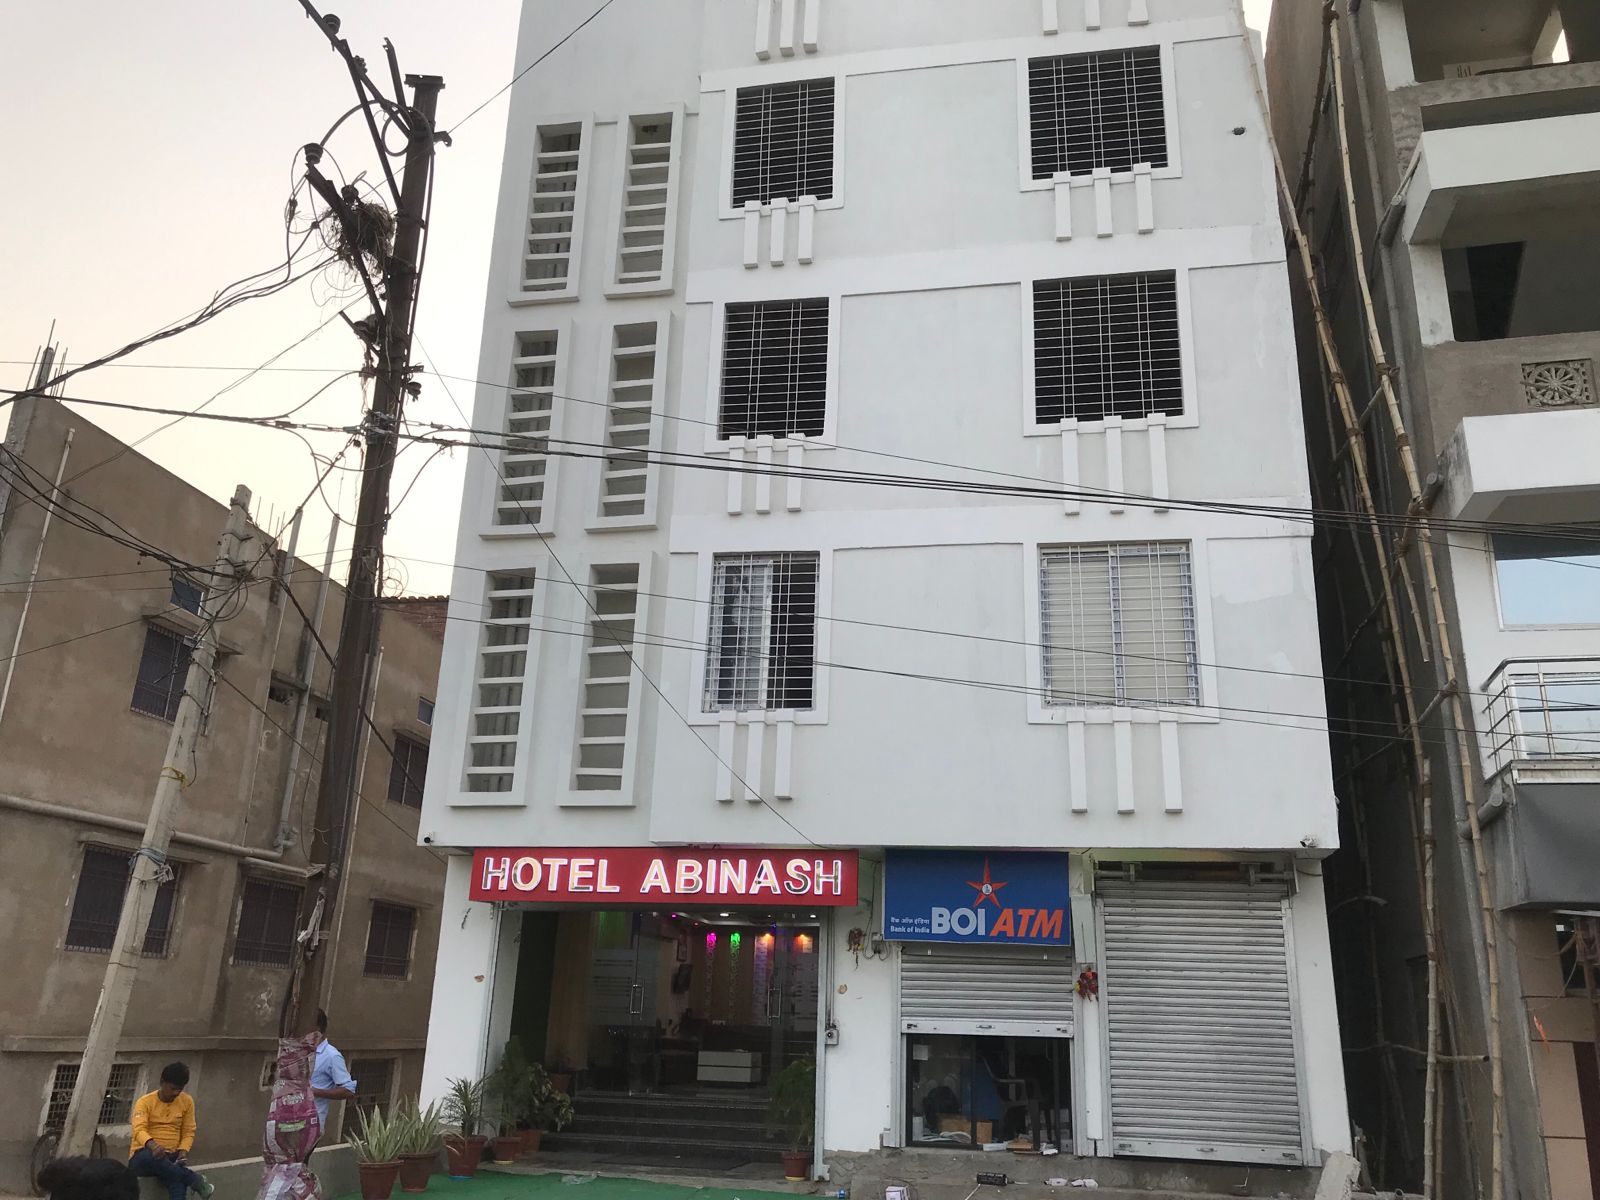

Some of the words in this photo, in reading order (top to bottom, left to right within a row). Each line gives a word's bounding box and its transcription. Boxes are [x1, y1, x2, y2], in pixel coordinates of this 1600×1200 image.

[481, 856, 620, 893] HOTEL
[639, 858, 842, 896] ABINASH
[890, 925, 906, 933] Bank
[914, 926, 930, 934] India
[931, 907, 986, 936] BOI
[989, 908, 1064, 938] ATM
